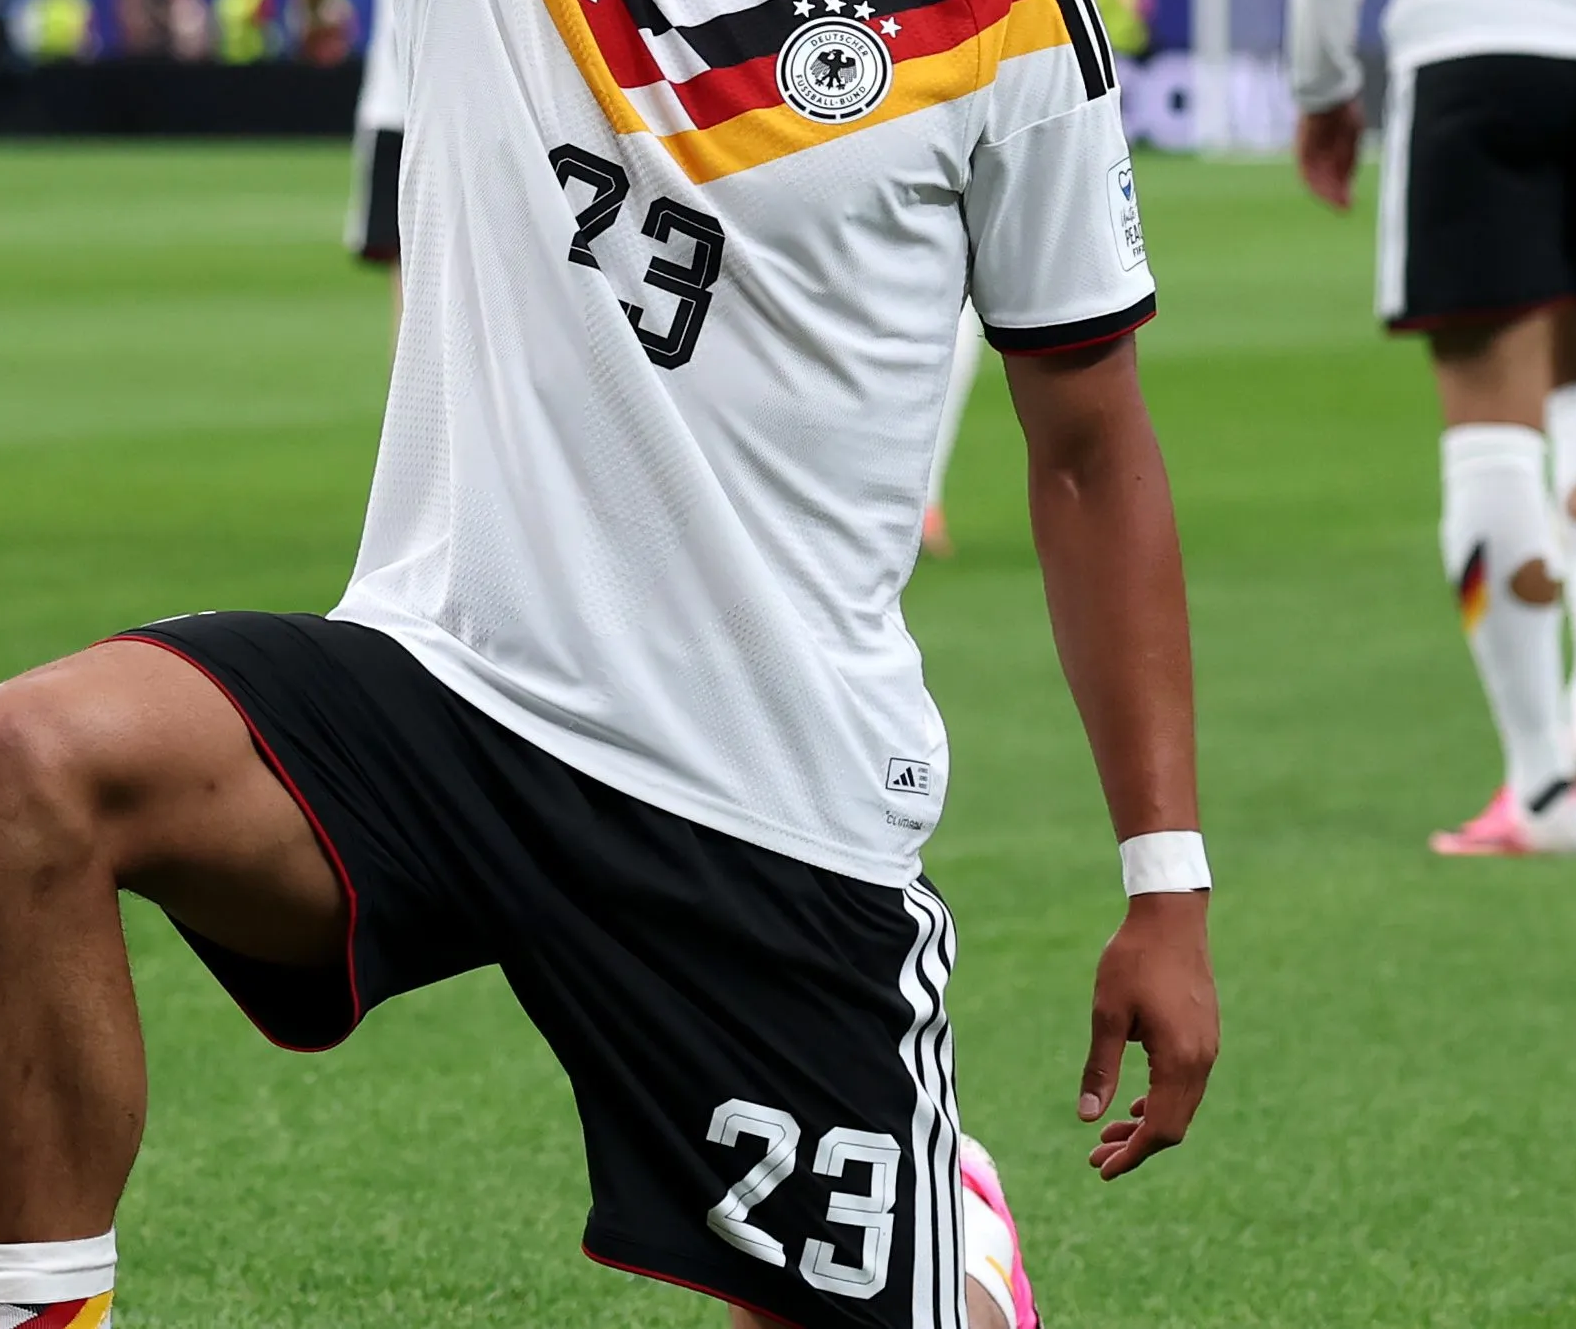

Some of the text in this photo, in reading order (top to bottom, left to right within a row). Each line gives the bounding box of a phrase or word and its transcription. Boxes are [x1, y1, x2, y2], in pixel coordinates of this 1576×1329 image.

[810, 33, 869, 58] DEUTSCHER
[548, 143, 726, 371] 23
[1132, 245, 1146, 258] FIF
[706, 1098, 902, 1300] 23
